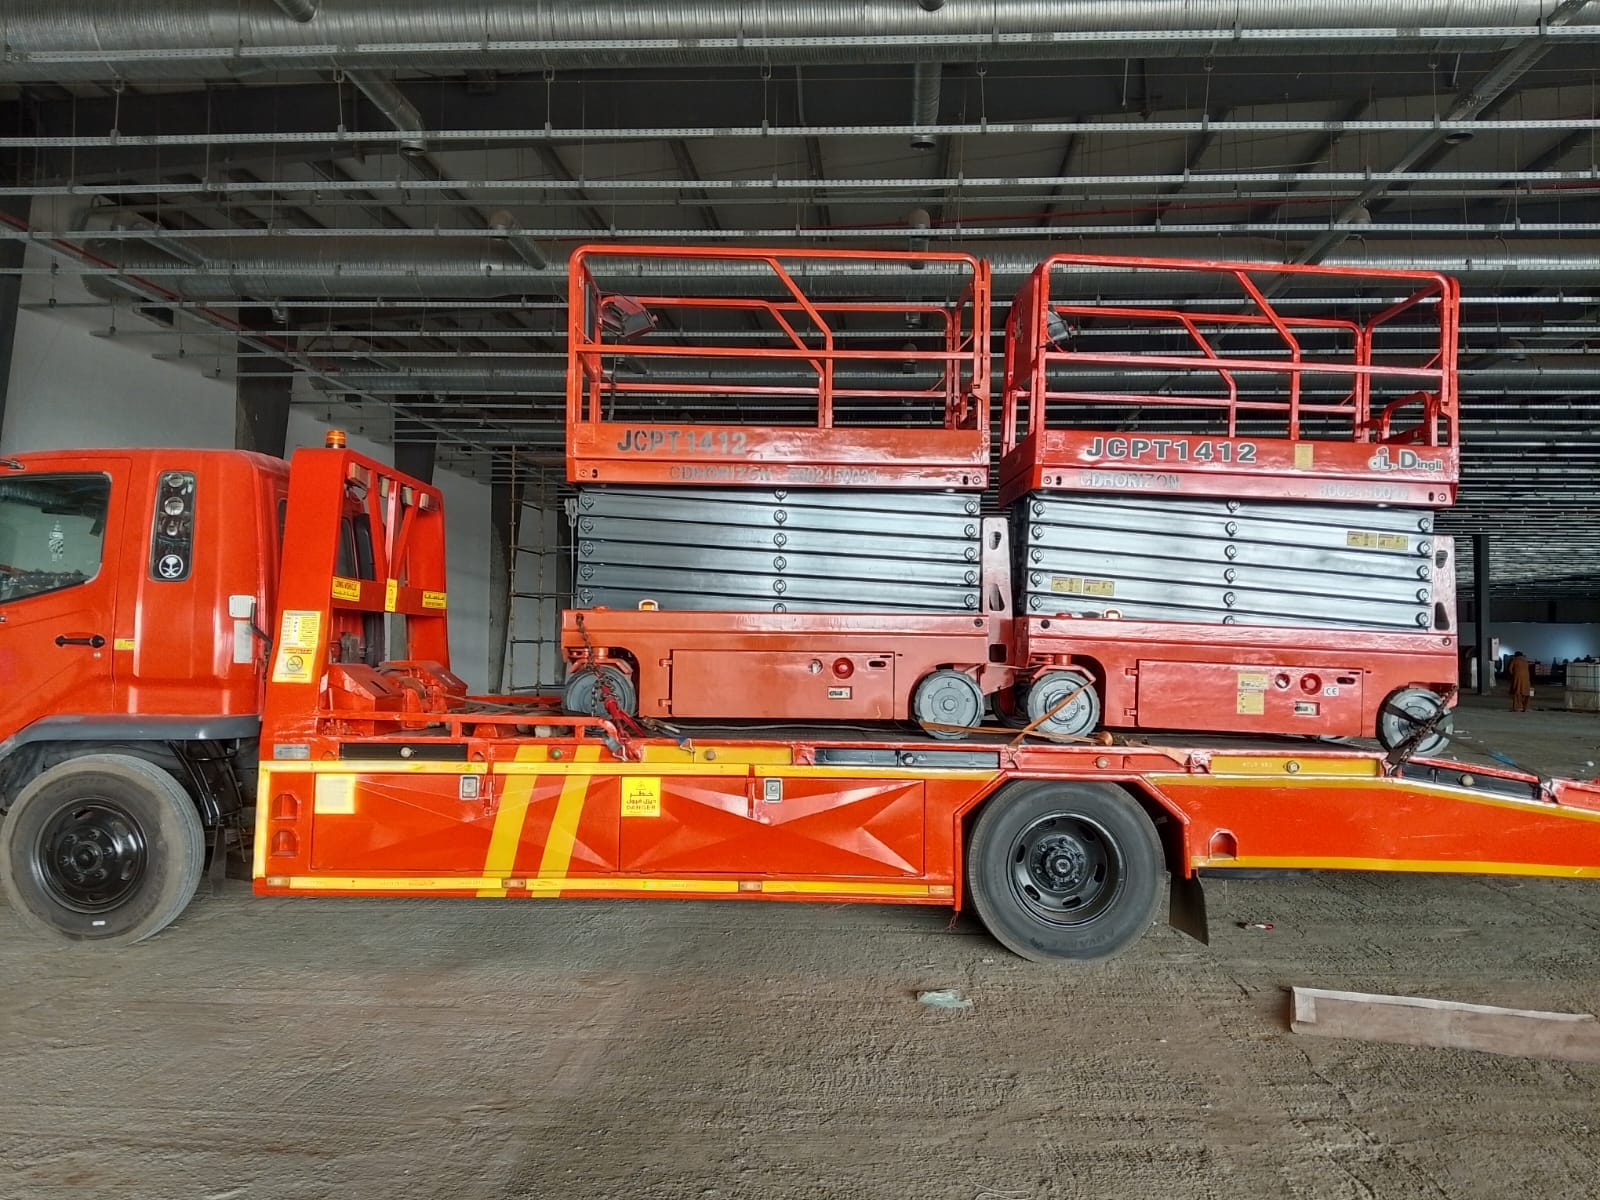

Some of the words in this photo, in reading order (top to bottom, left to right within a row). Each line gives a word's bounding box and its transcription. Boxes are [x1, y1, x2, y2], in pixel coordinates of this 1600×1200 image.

[617, 428, 747, 453] JCPT1412
[1086, 437, 1256, 463] JCPT1412
[1399, 449, 1443, 471] Dingli
[1326, 687, 1337, 695] CE
